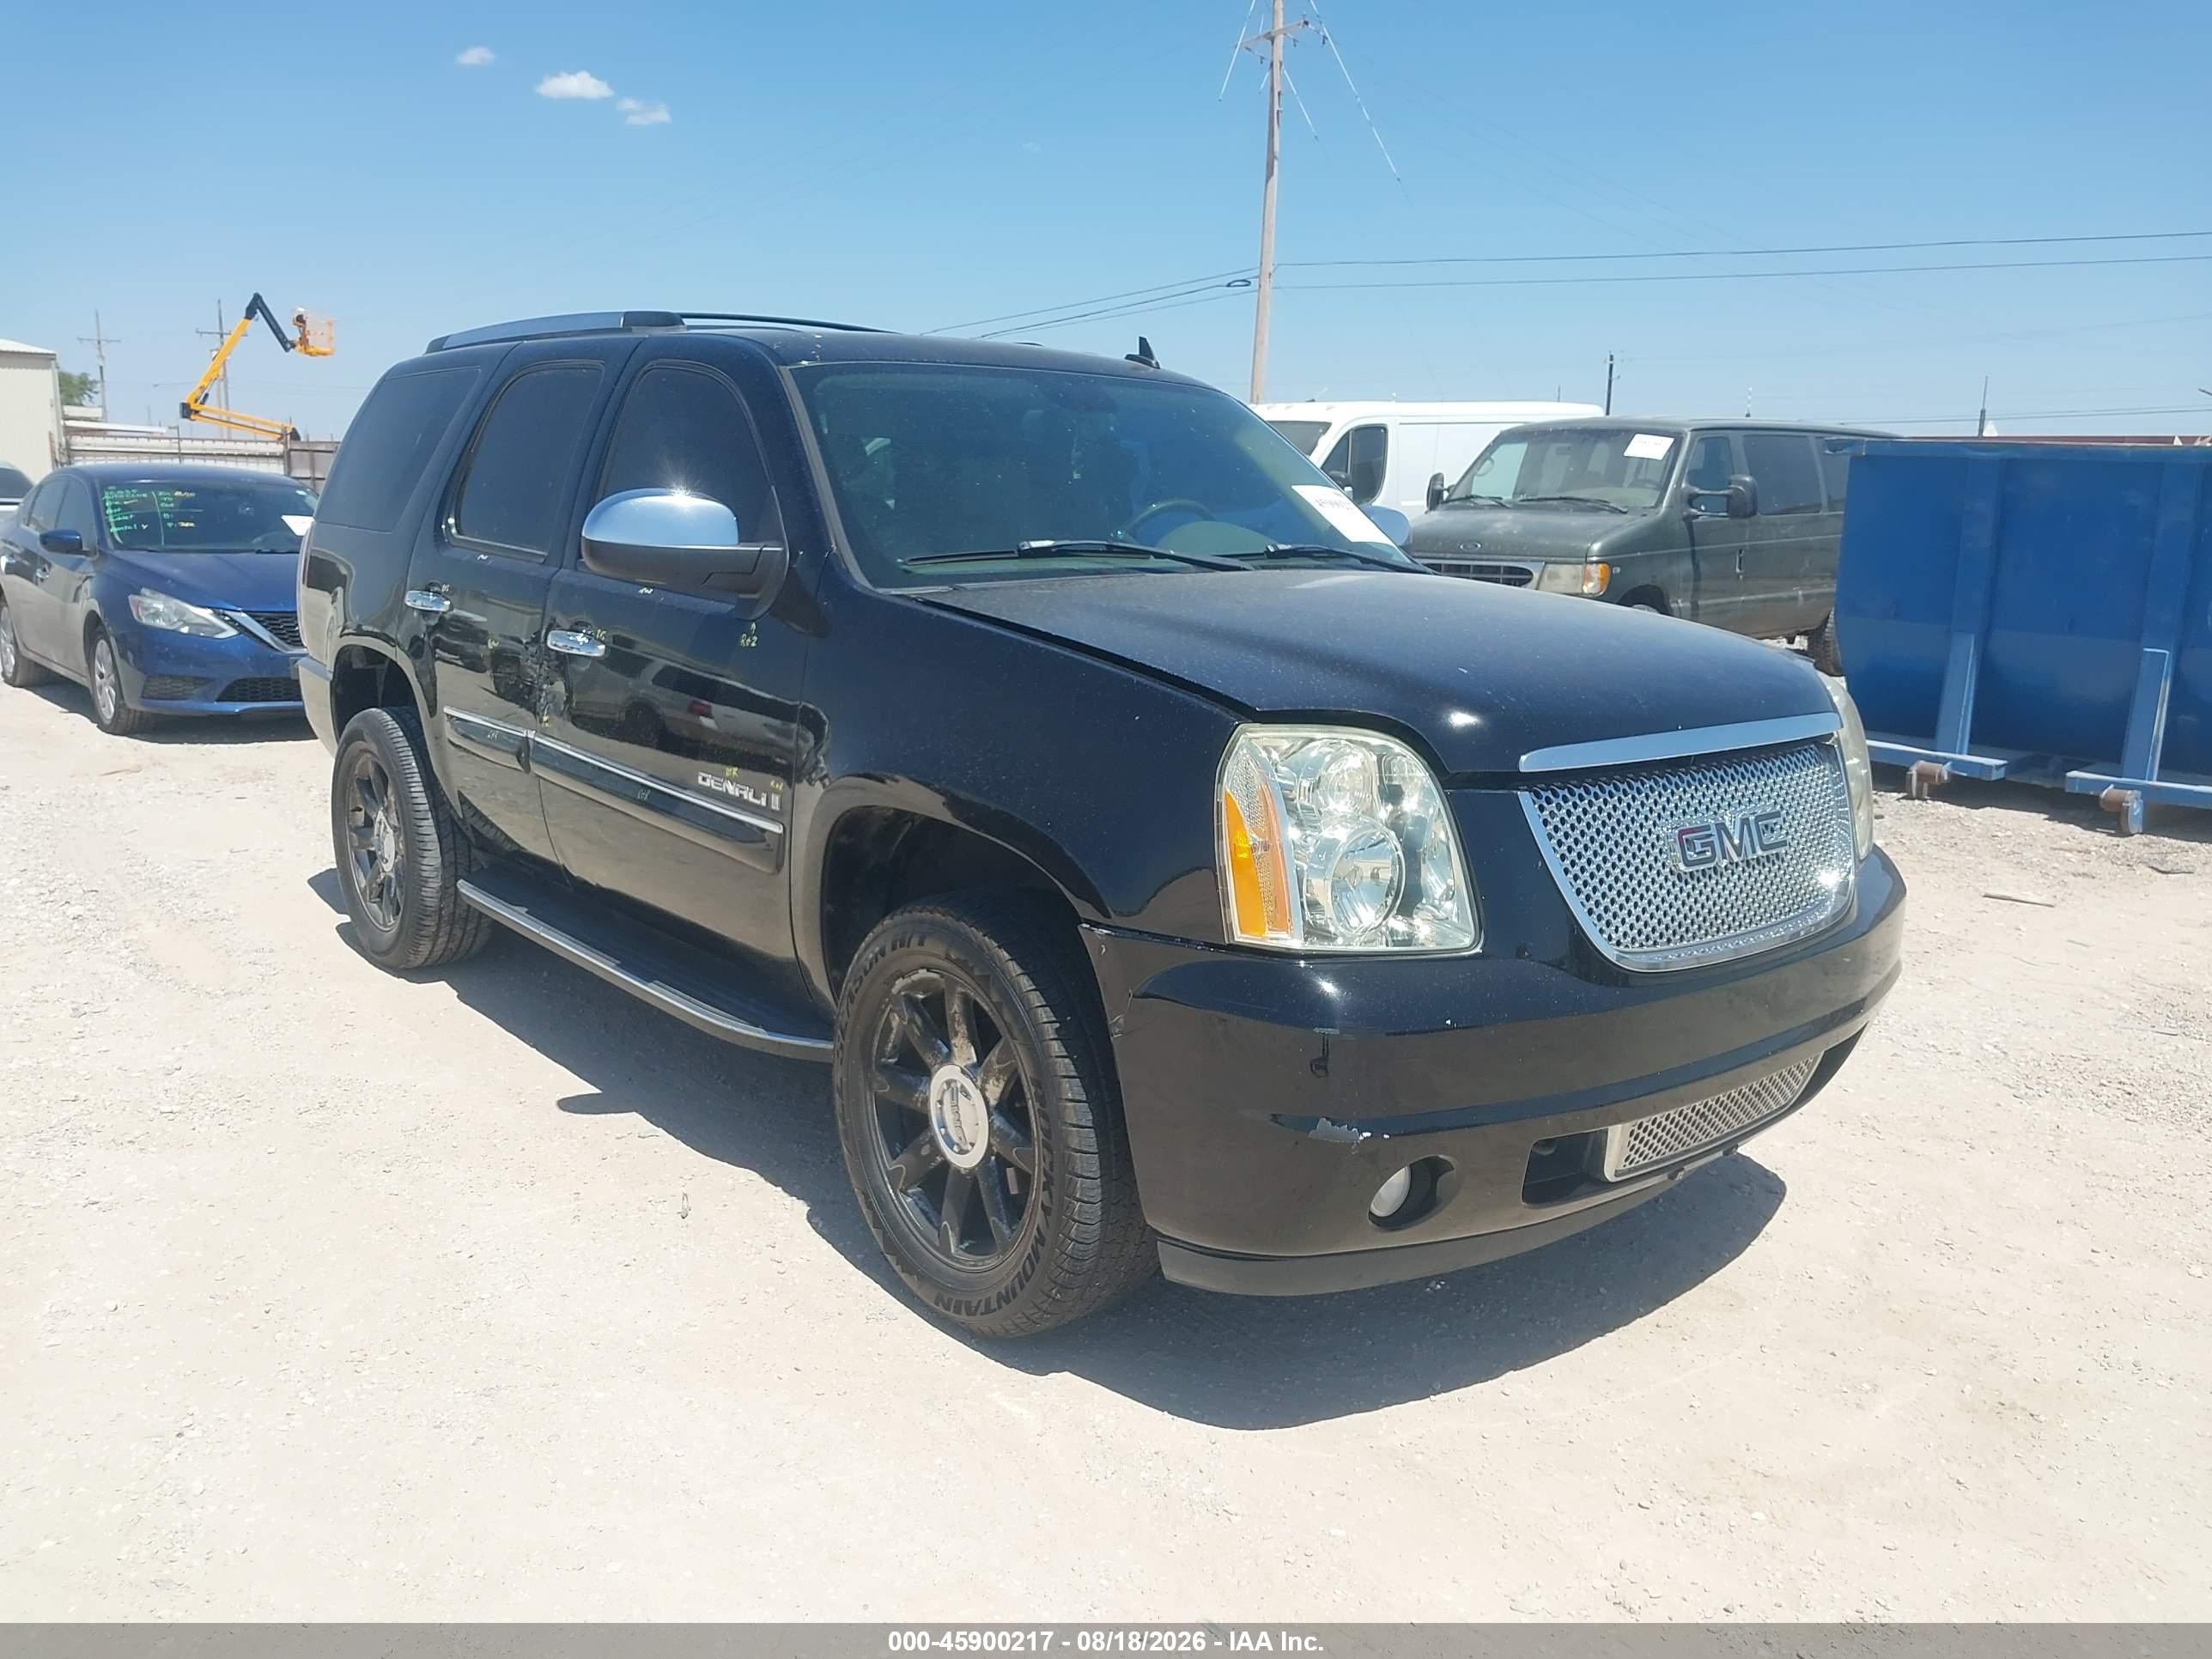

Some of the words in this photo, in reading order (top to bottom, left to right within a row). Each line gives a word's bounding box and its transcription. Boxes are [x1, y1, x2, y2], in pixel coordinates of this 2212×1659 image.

[697, 771, 768, 807] DENALI
[1677, 810, 1788, 868] GMC
[933, 1224, 1047, 1317] MOUNTAIN
